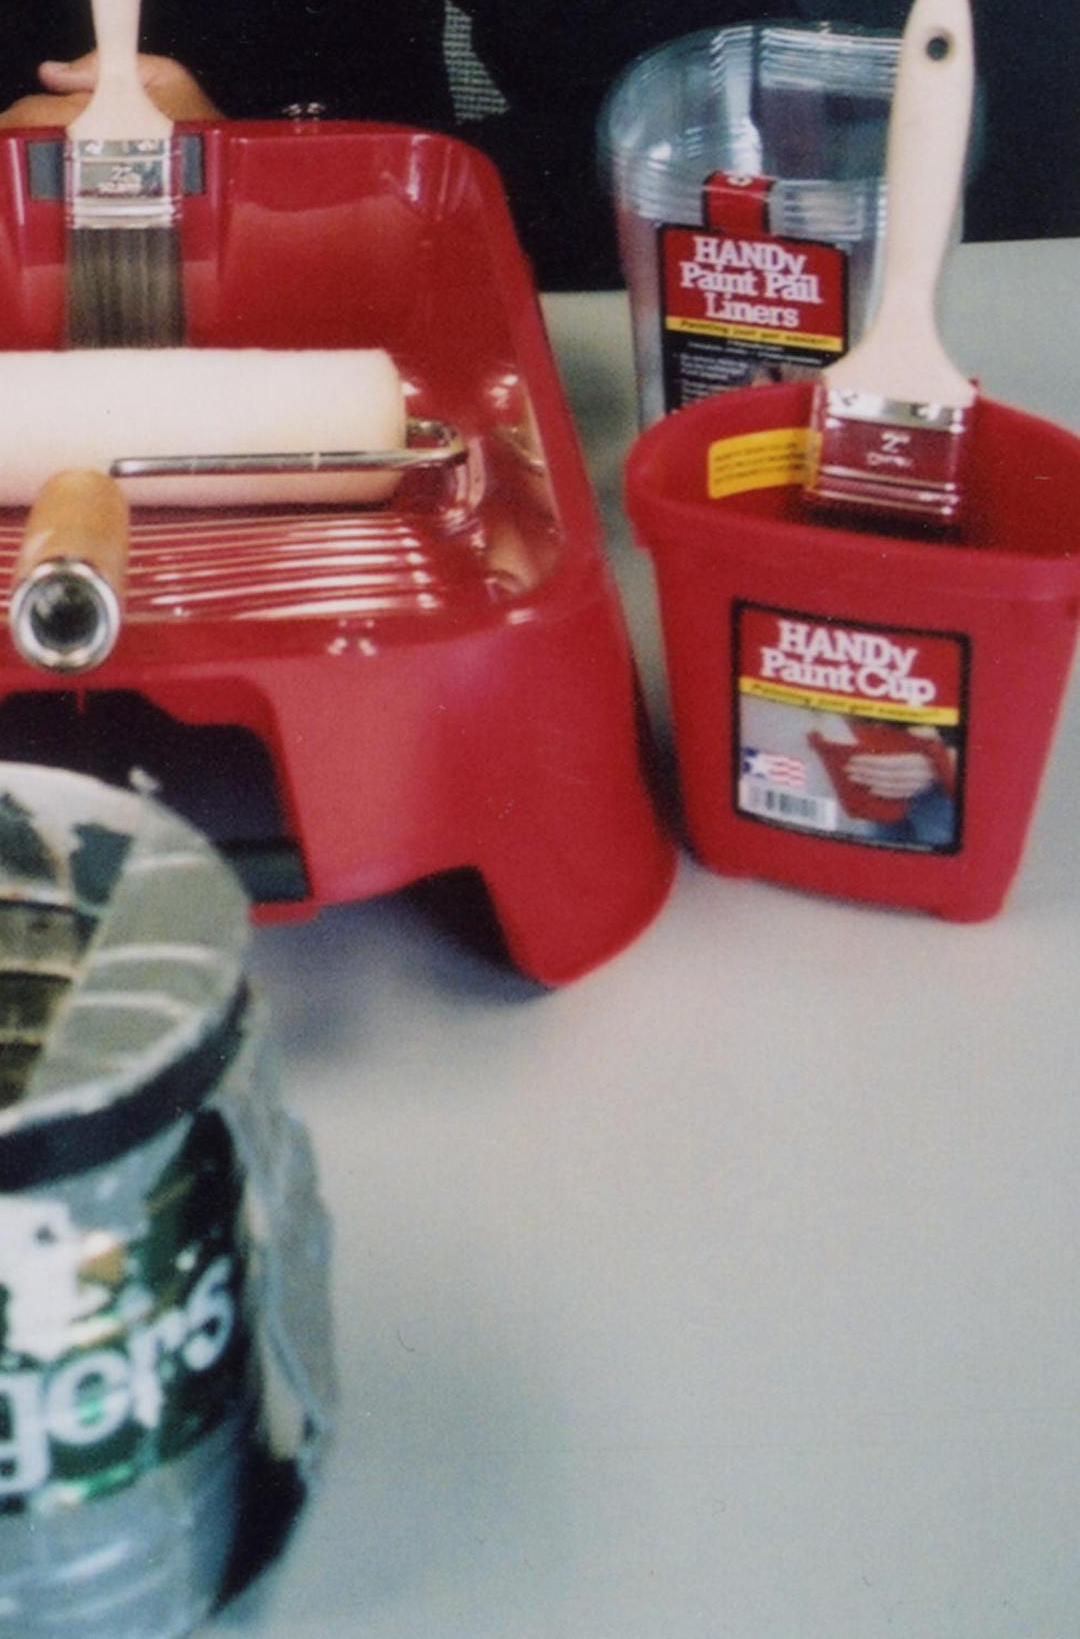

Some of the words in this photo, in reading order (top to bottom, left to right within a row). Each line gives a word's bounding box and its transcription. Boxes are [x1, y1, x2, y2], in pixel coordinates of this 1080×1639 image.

[680, 261, 759, 296] Paint
[764, 269, 824, 304] Pail
[704, 290, 800, 328] Liners
[760, 647, 855, 693] Paint
[856, 664, 937, 709] Cup
